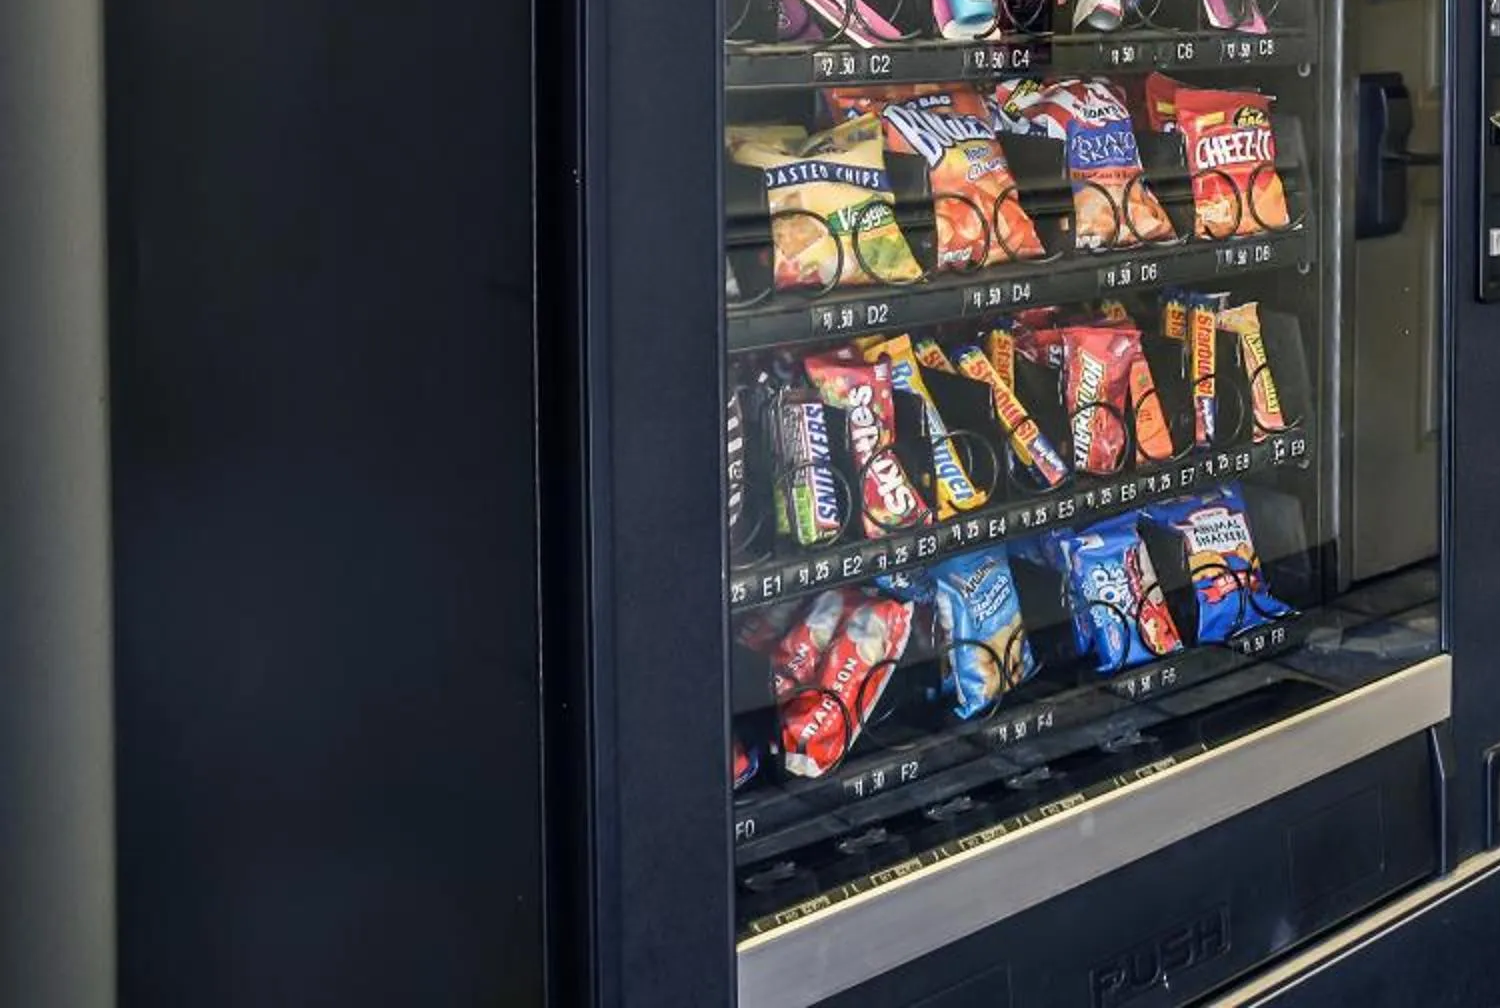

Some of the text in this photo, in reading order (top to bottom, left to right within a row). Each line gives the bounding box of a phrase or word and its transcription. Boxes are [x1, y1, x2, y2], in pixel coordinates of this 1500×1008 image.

[1012, 49, 1030, 68] C4
[1177, 43, 1193, 59] C6
[870, 55, 890, 74] C2
[836, 167, 879, 187] CHIPS
[1013, 282, 1030, 302] D4
[867, 304, 889, 325] D2
[1181, 467, 1195, 486] E7
[1121, 483, 1136, 502] E6
[1058, 499, 1075, 519] E5
[989, 517, 1006, 538] E4
[918, 536, 937, 557] E3
[843, 555, 863, 576] E2
[762, 575, 781, 597] E1
[1038, 712, 1053, 732] F4
[901, 762, 918, 782] F2
[735, 819, 755, 840] F0
